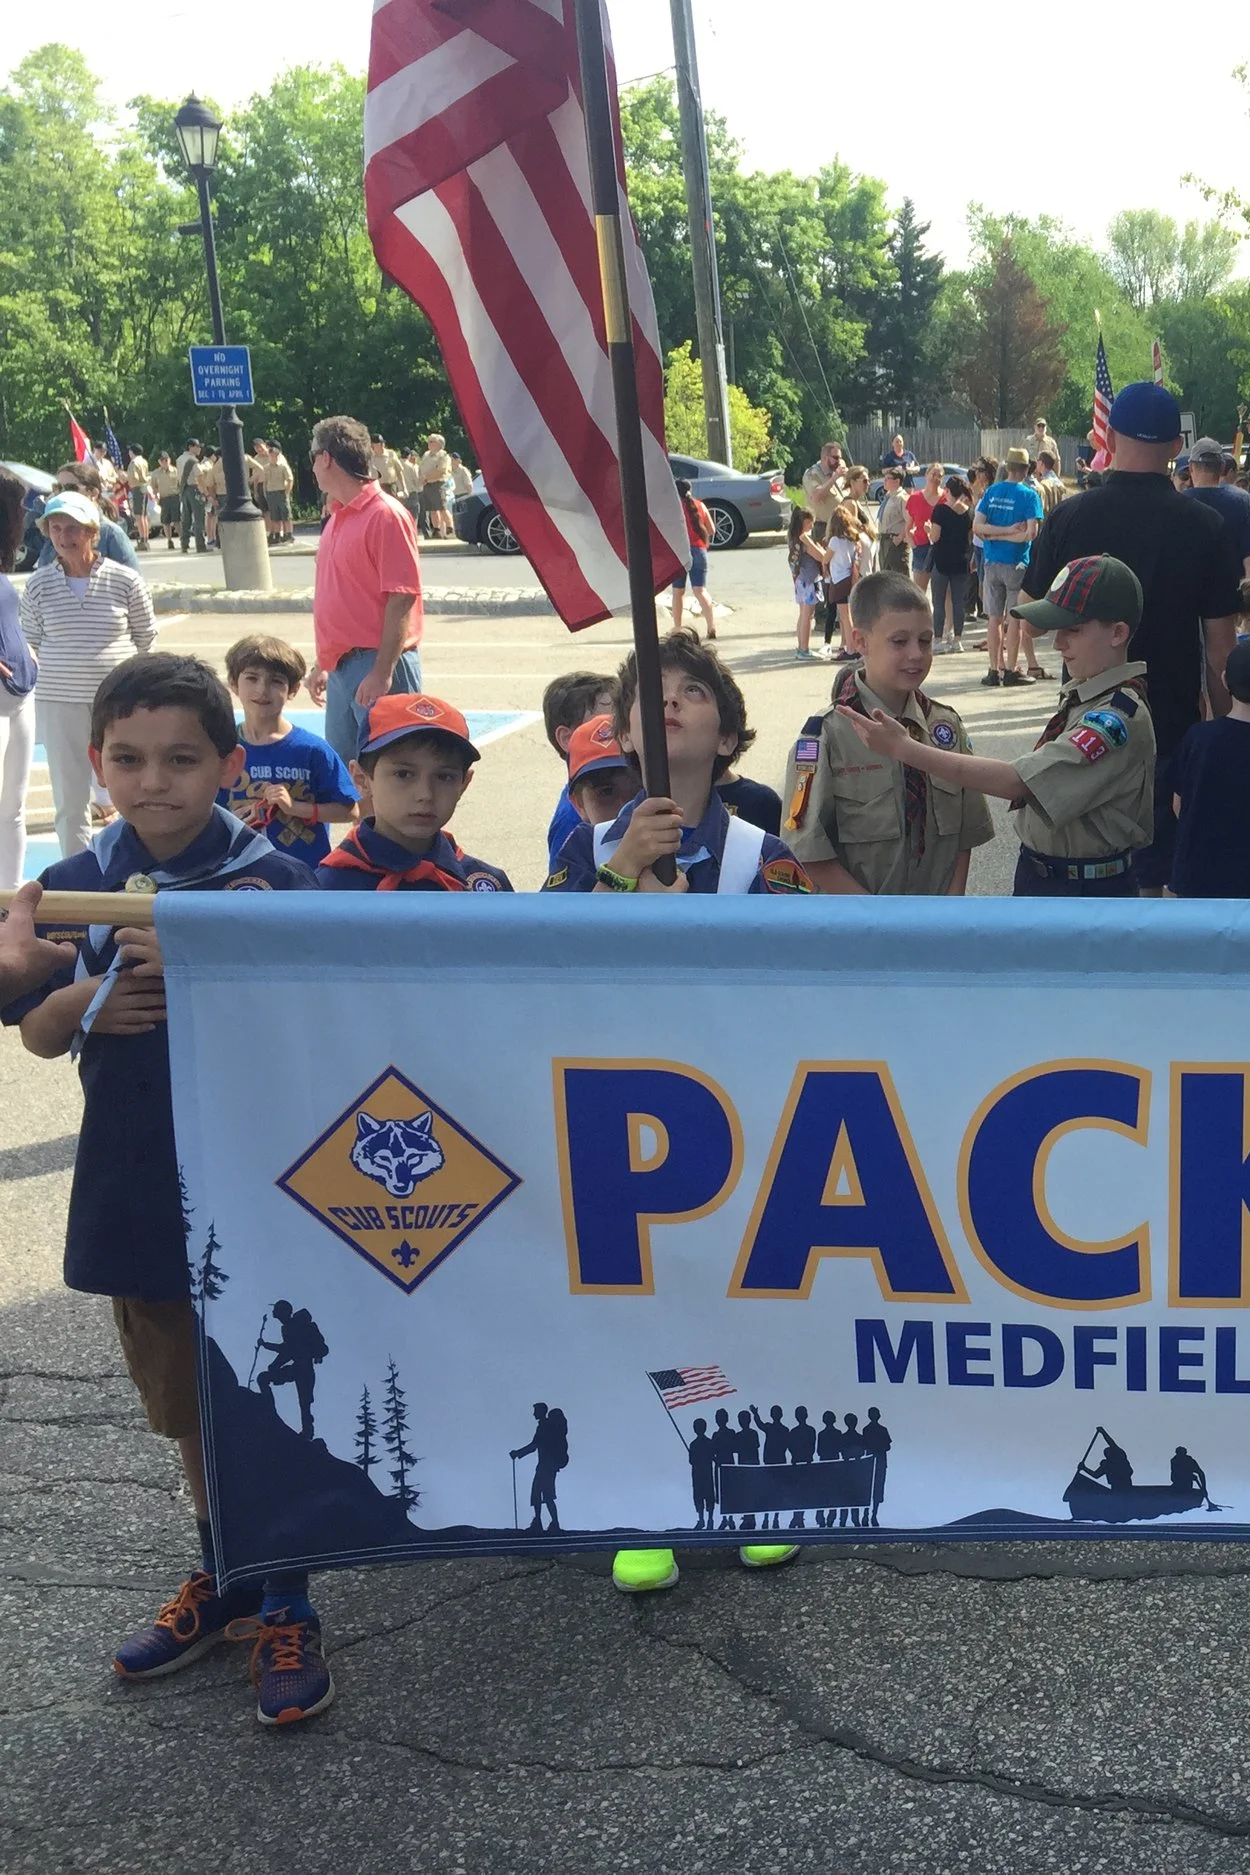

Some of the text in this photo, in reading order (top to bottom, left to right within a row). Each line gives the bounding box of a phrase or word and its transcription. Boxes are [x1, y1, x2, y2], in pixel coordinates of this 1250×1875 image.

[213, 352, 226, 363] NO
[197, 365, 244, 376] OVERNIGHT
[204, 377, 241, 388] PARKING
[1072, 729, 1106, 760] 113
[250, 765, 312, 780] CUB SCOUT
[327, 1203, 481, 1231] CUB SCOUTS
